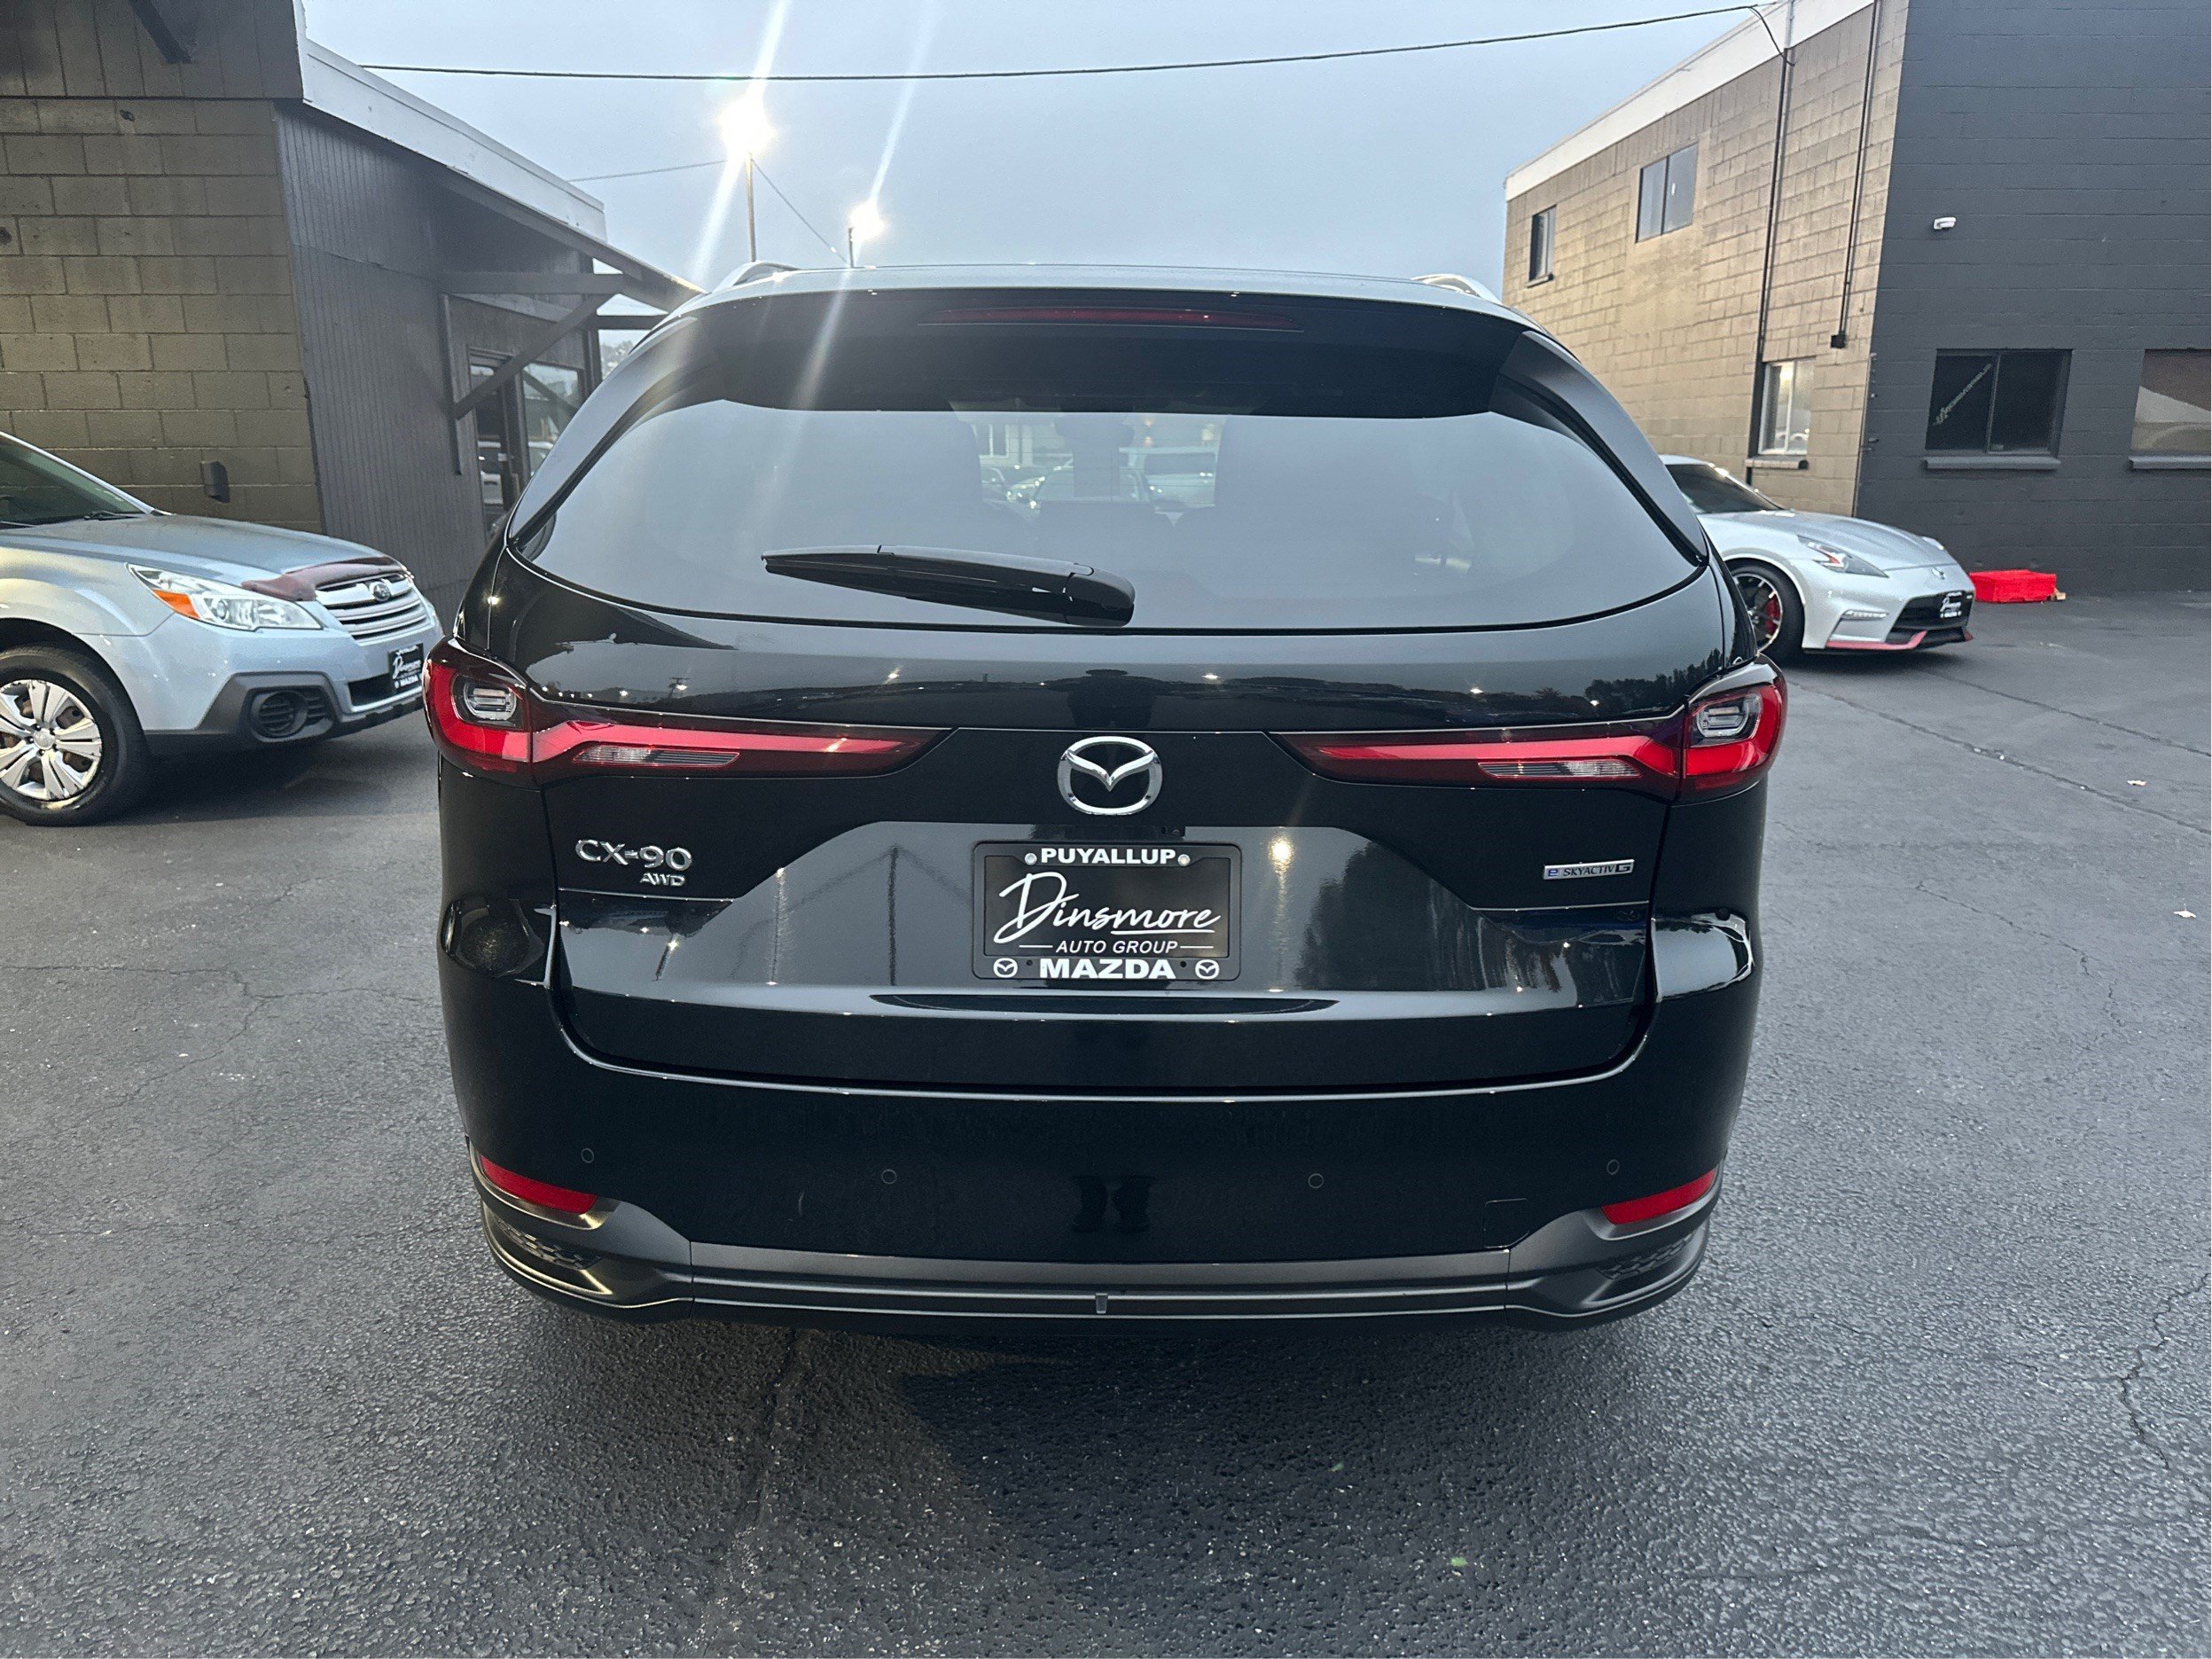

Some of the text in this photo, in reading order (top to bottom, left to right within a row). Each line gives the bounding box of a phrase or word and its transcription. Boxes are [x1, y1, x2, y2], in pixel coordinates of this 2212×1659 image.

[575, 839, 692, 872] CX-90
[1041, 848, 1176, 865] PUYALLUP
[639, 873, 685, 887] AWD
[993, 872, 1221, 943] Dinsmore
[1056, 940, 1178, 954] AUTO GROUP
[1039, 958, 1176, 979] MAZDA
